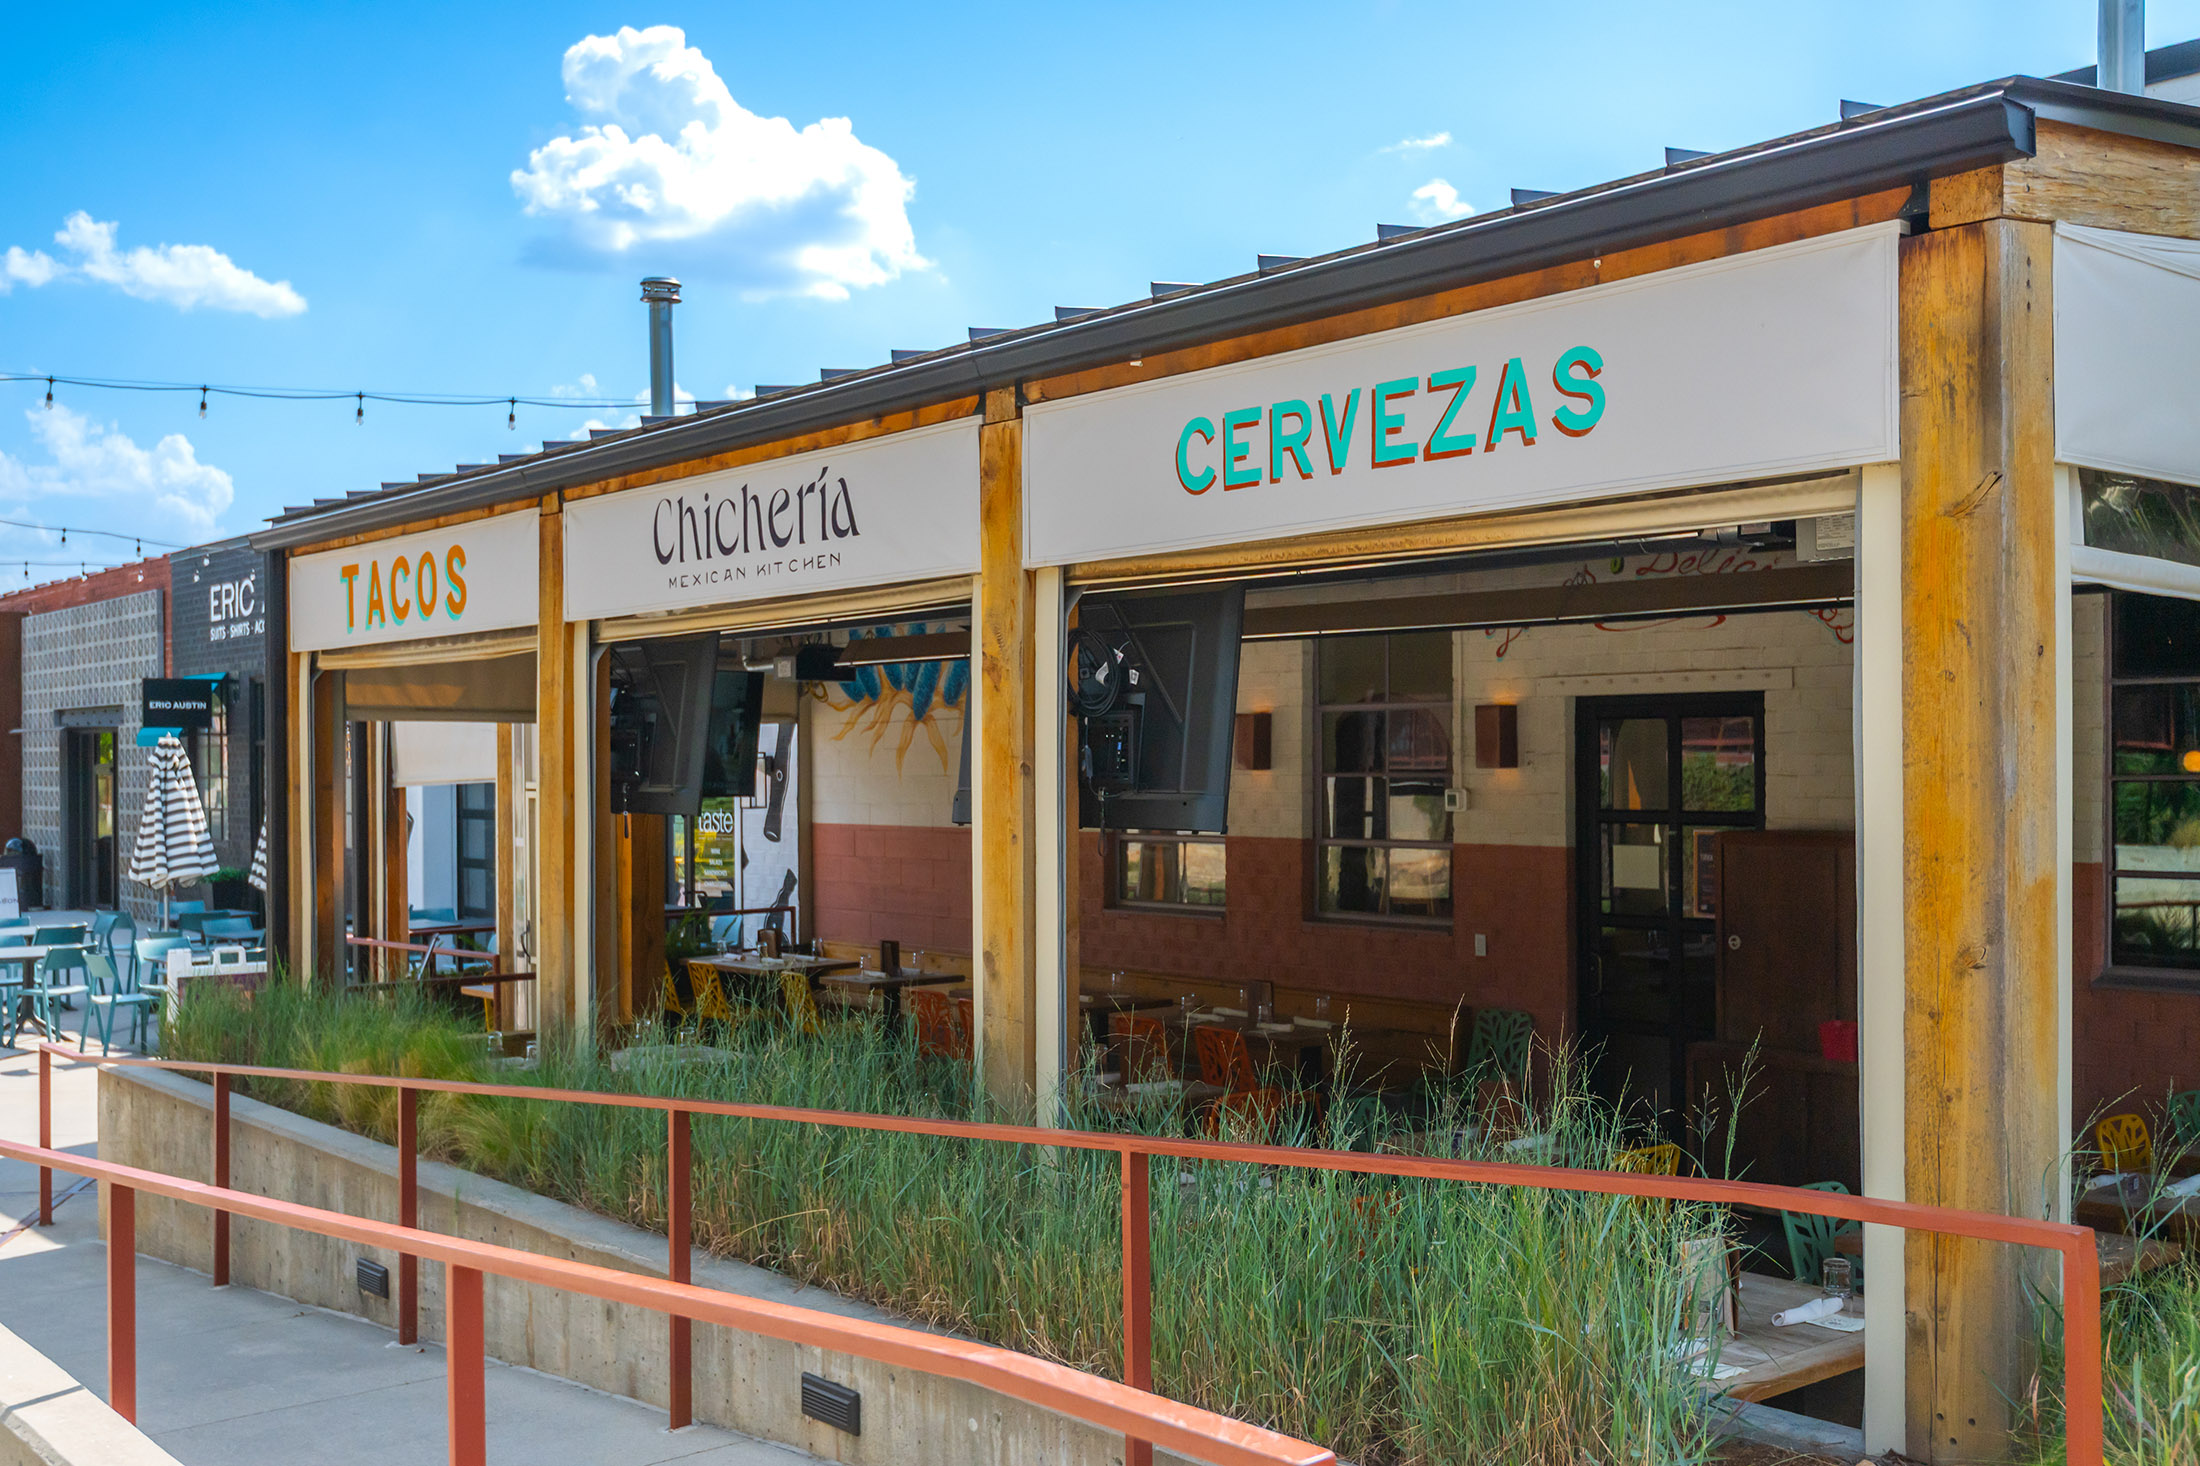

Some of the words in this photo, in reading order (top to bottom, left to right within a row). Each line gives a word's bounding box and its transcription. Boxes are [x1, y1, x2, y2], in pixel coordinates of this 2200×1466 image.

[1175, 345, 1606, 495] CERVEZAS
[653, 466, 860, 565] Chichería
[340, 544, 467, 634] TACOS
[668, 567, 746, 589] MEXICAN
[756, 552, 842, 577] KITCHEN
[210, 579, 255, 622] ERIC
[210, 625, 226, 641] SUITS
[230, 621, 250, 638] SHIRTS
[149, 701, 172, 710] ERIC
[172, 701, 207, 710] AUSTIN
